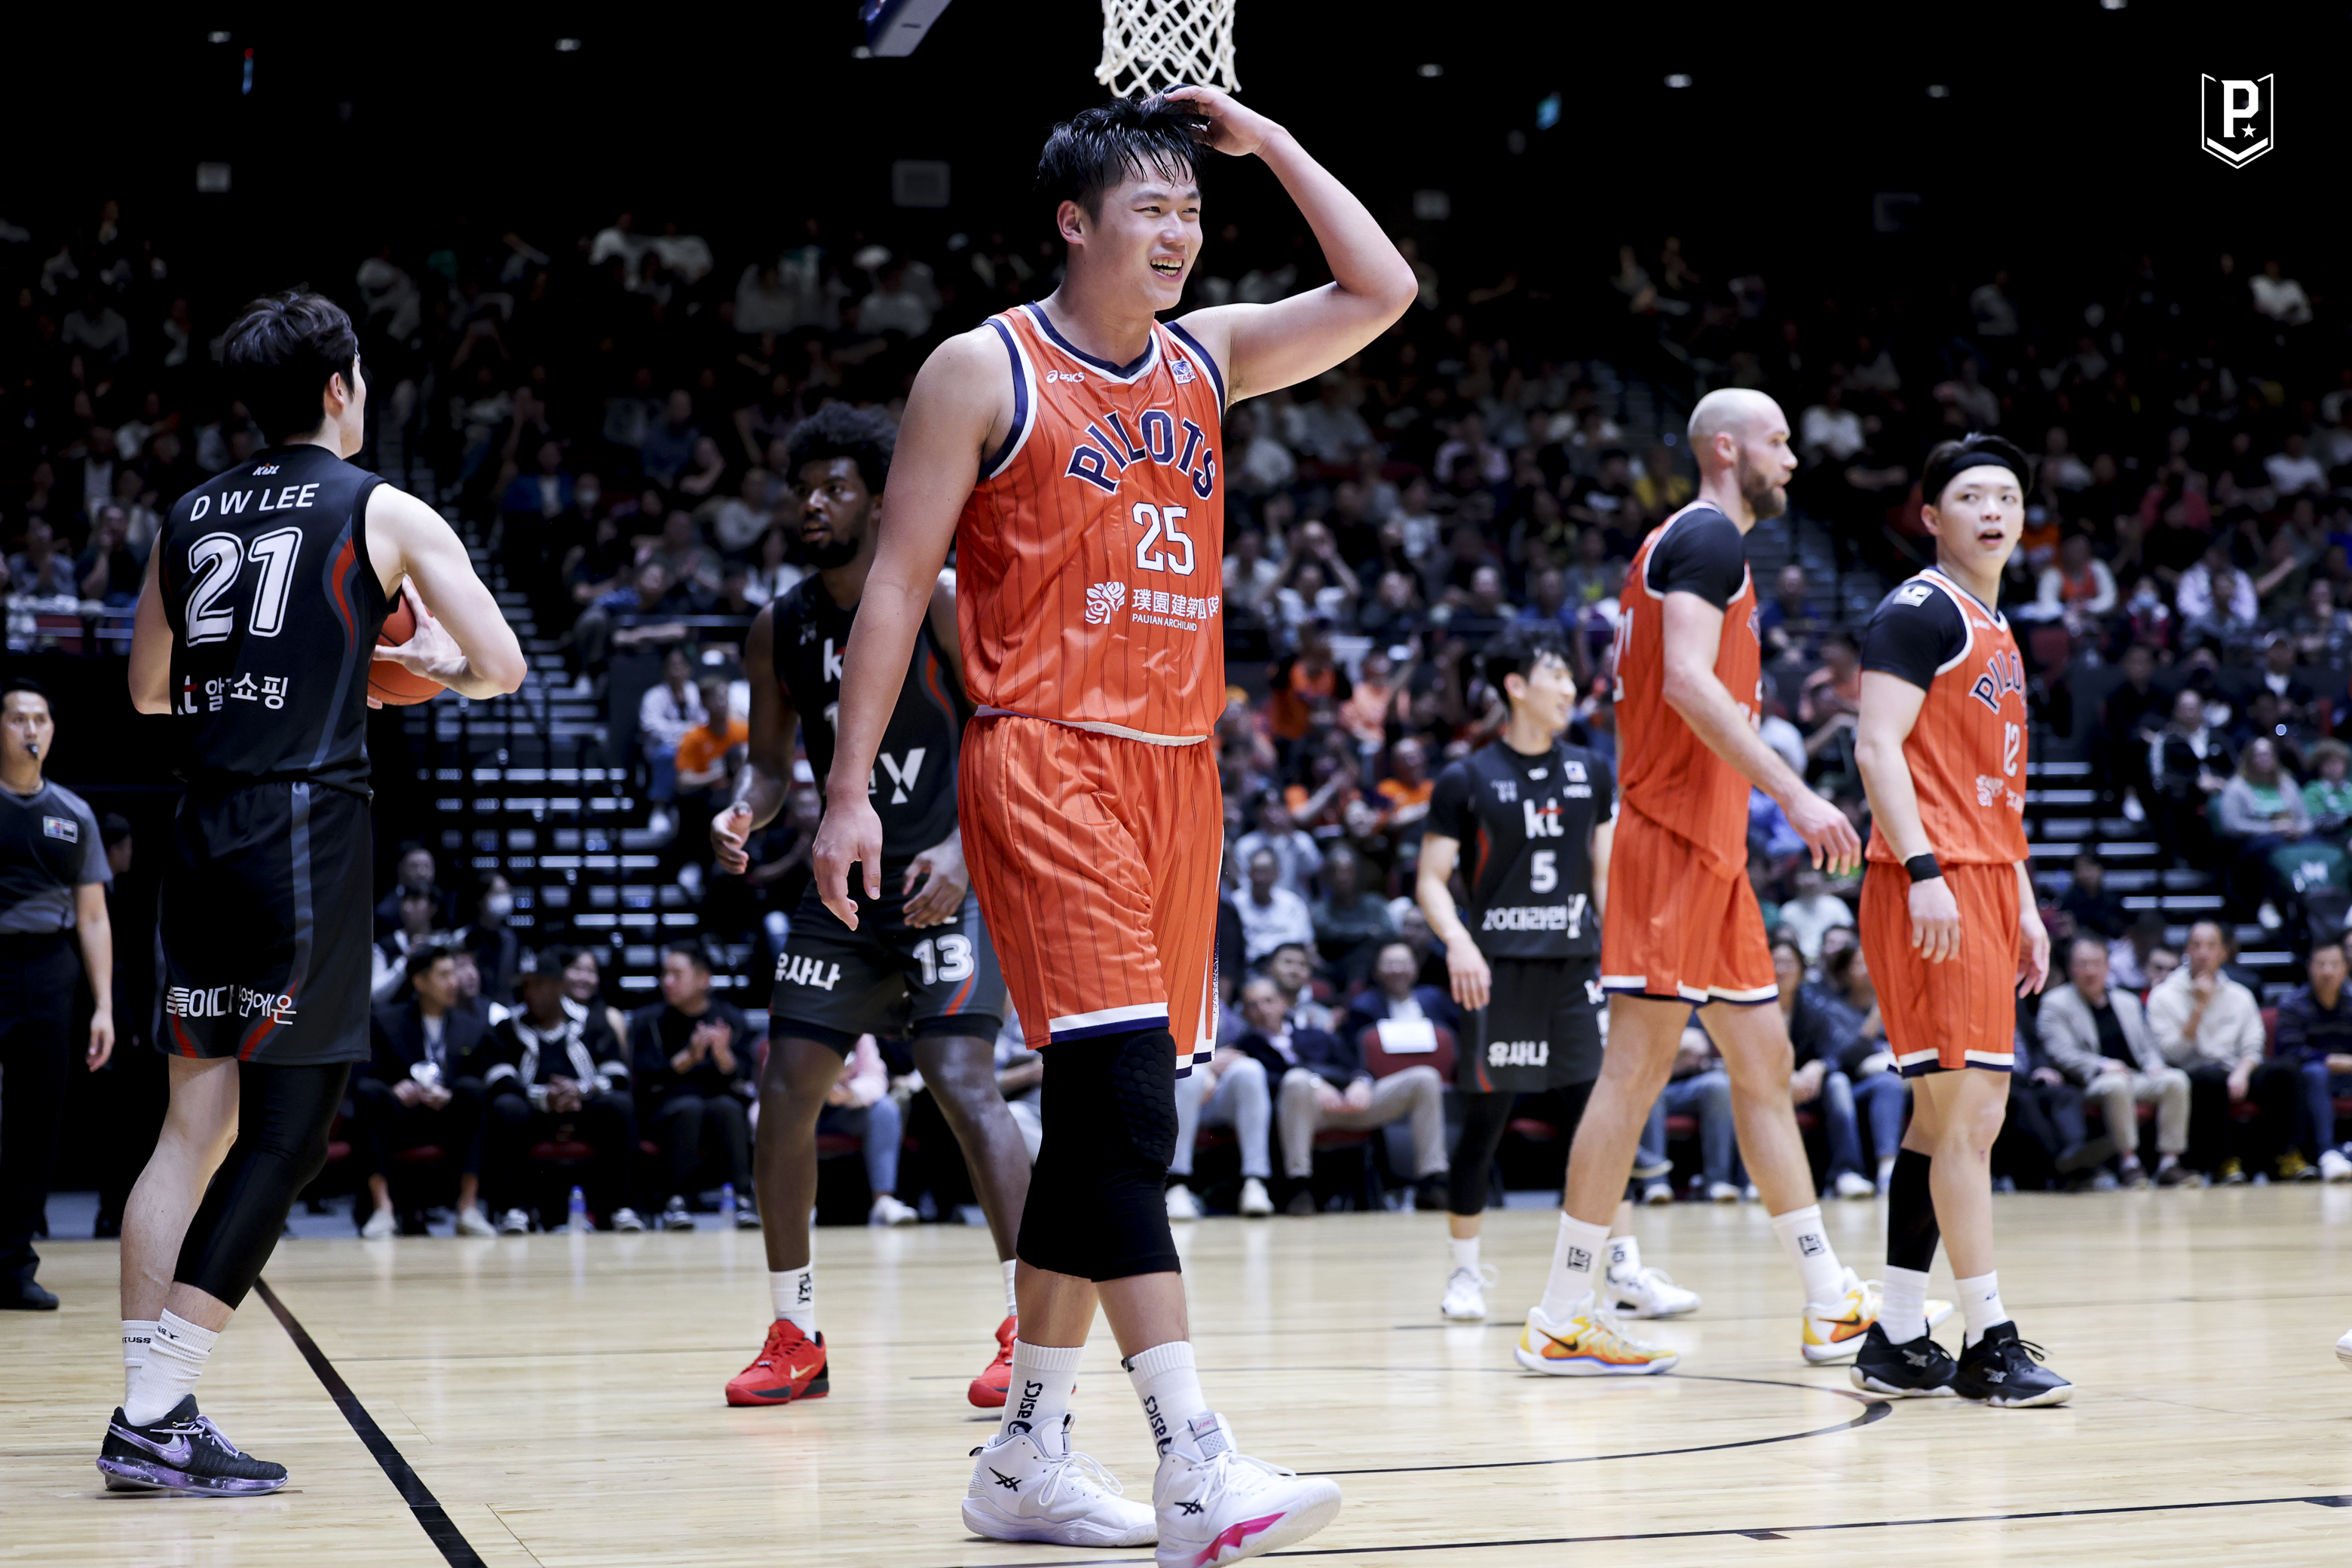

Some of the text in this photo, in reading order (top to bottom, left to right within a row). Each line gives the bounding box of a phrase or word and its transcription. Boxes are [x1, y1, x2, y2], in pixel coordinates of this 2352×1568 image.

[1064, 409, 1216, 501] PILOTS
[190, 483, 320, 522] D W LEE
[1132, 502, 1196, 576] 25
[186, 526, 303, 647] 21
[1132, 613, 1197, 632] PAUIAN ARCHILAND
[823, 637, 843, 683] k
[205, 672, 289, 712] 알쇼핑
[2004, 721, 2020, 777] 12
[1523, 797, 1564, 839] kt
[1530, 850, 1558, 893] 5
[913, 934, 974, 985] 13
